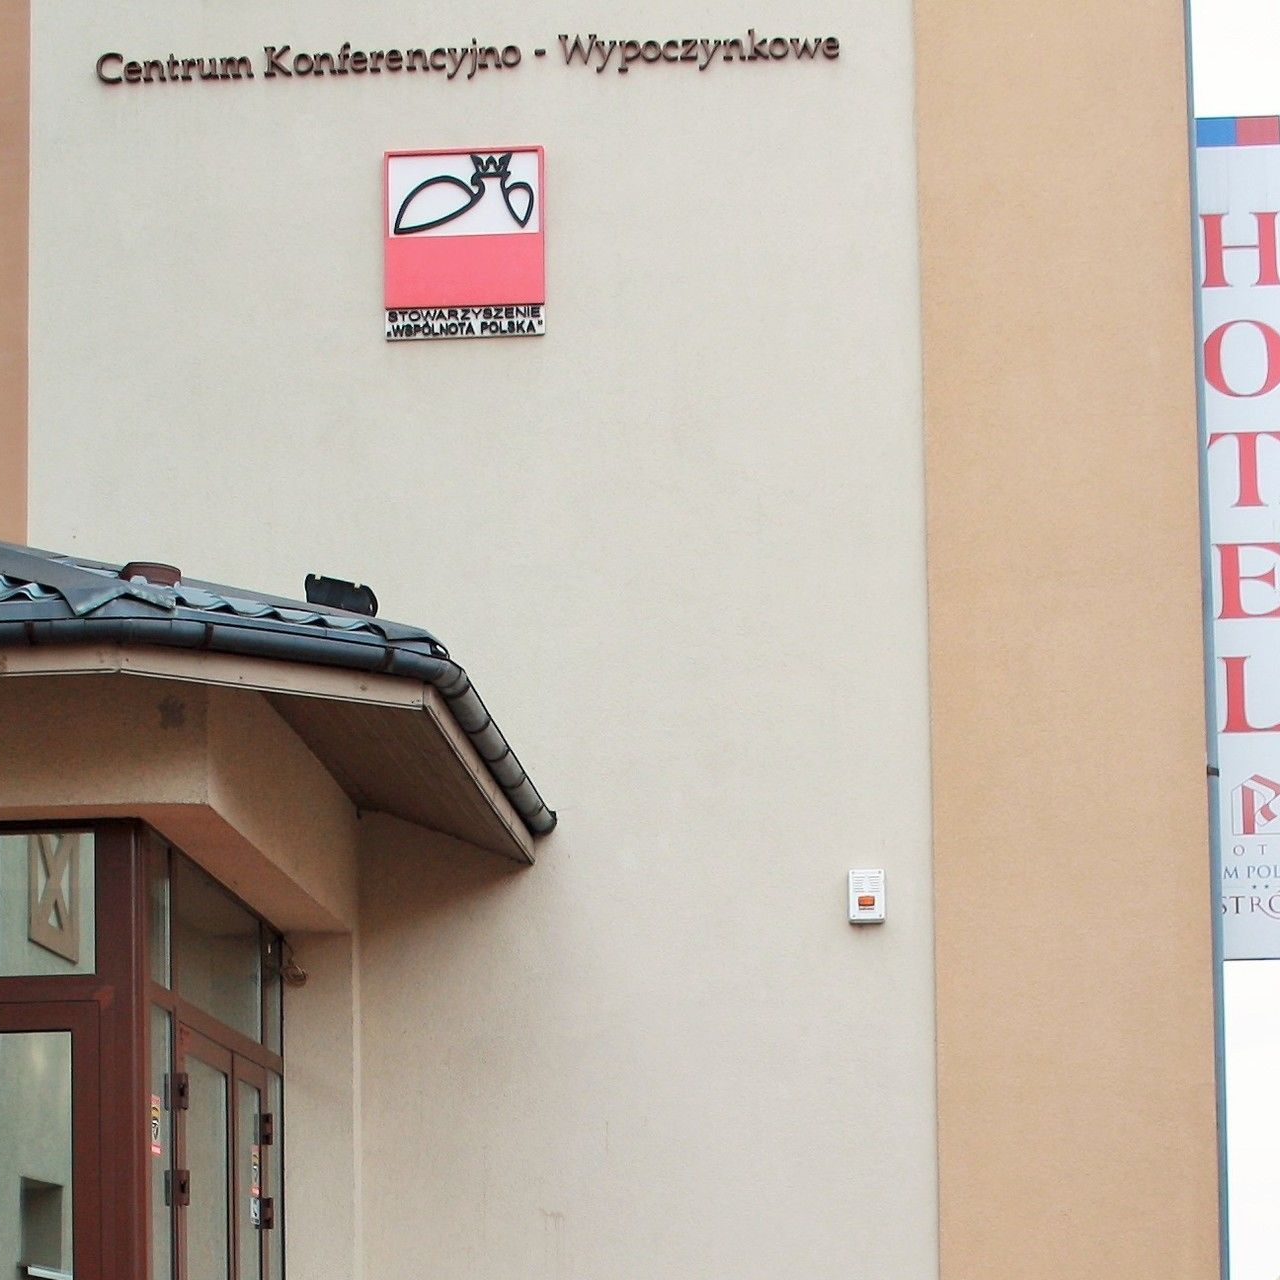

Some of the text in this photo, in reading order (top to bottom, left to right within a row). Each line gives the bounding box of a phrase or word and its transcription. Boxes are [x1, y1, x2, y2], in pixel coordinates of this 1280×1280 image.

[96, 52, 254, 84] Centrum
[264, 38, 522, 80] Konferencyjno
[558, 28, 840, 74] Wypoczynkowe
[388, 306, 541, 323] STOWARZYSZENIE
